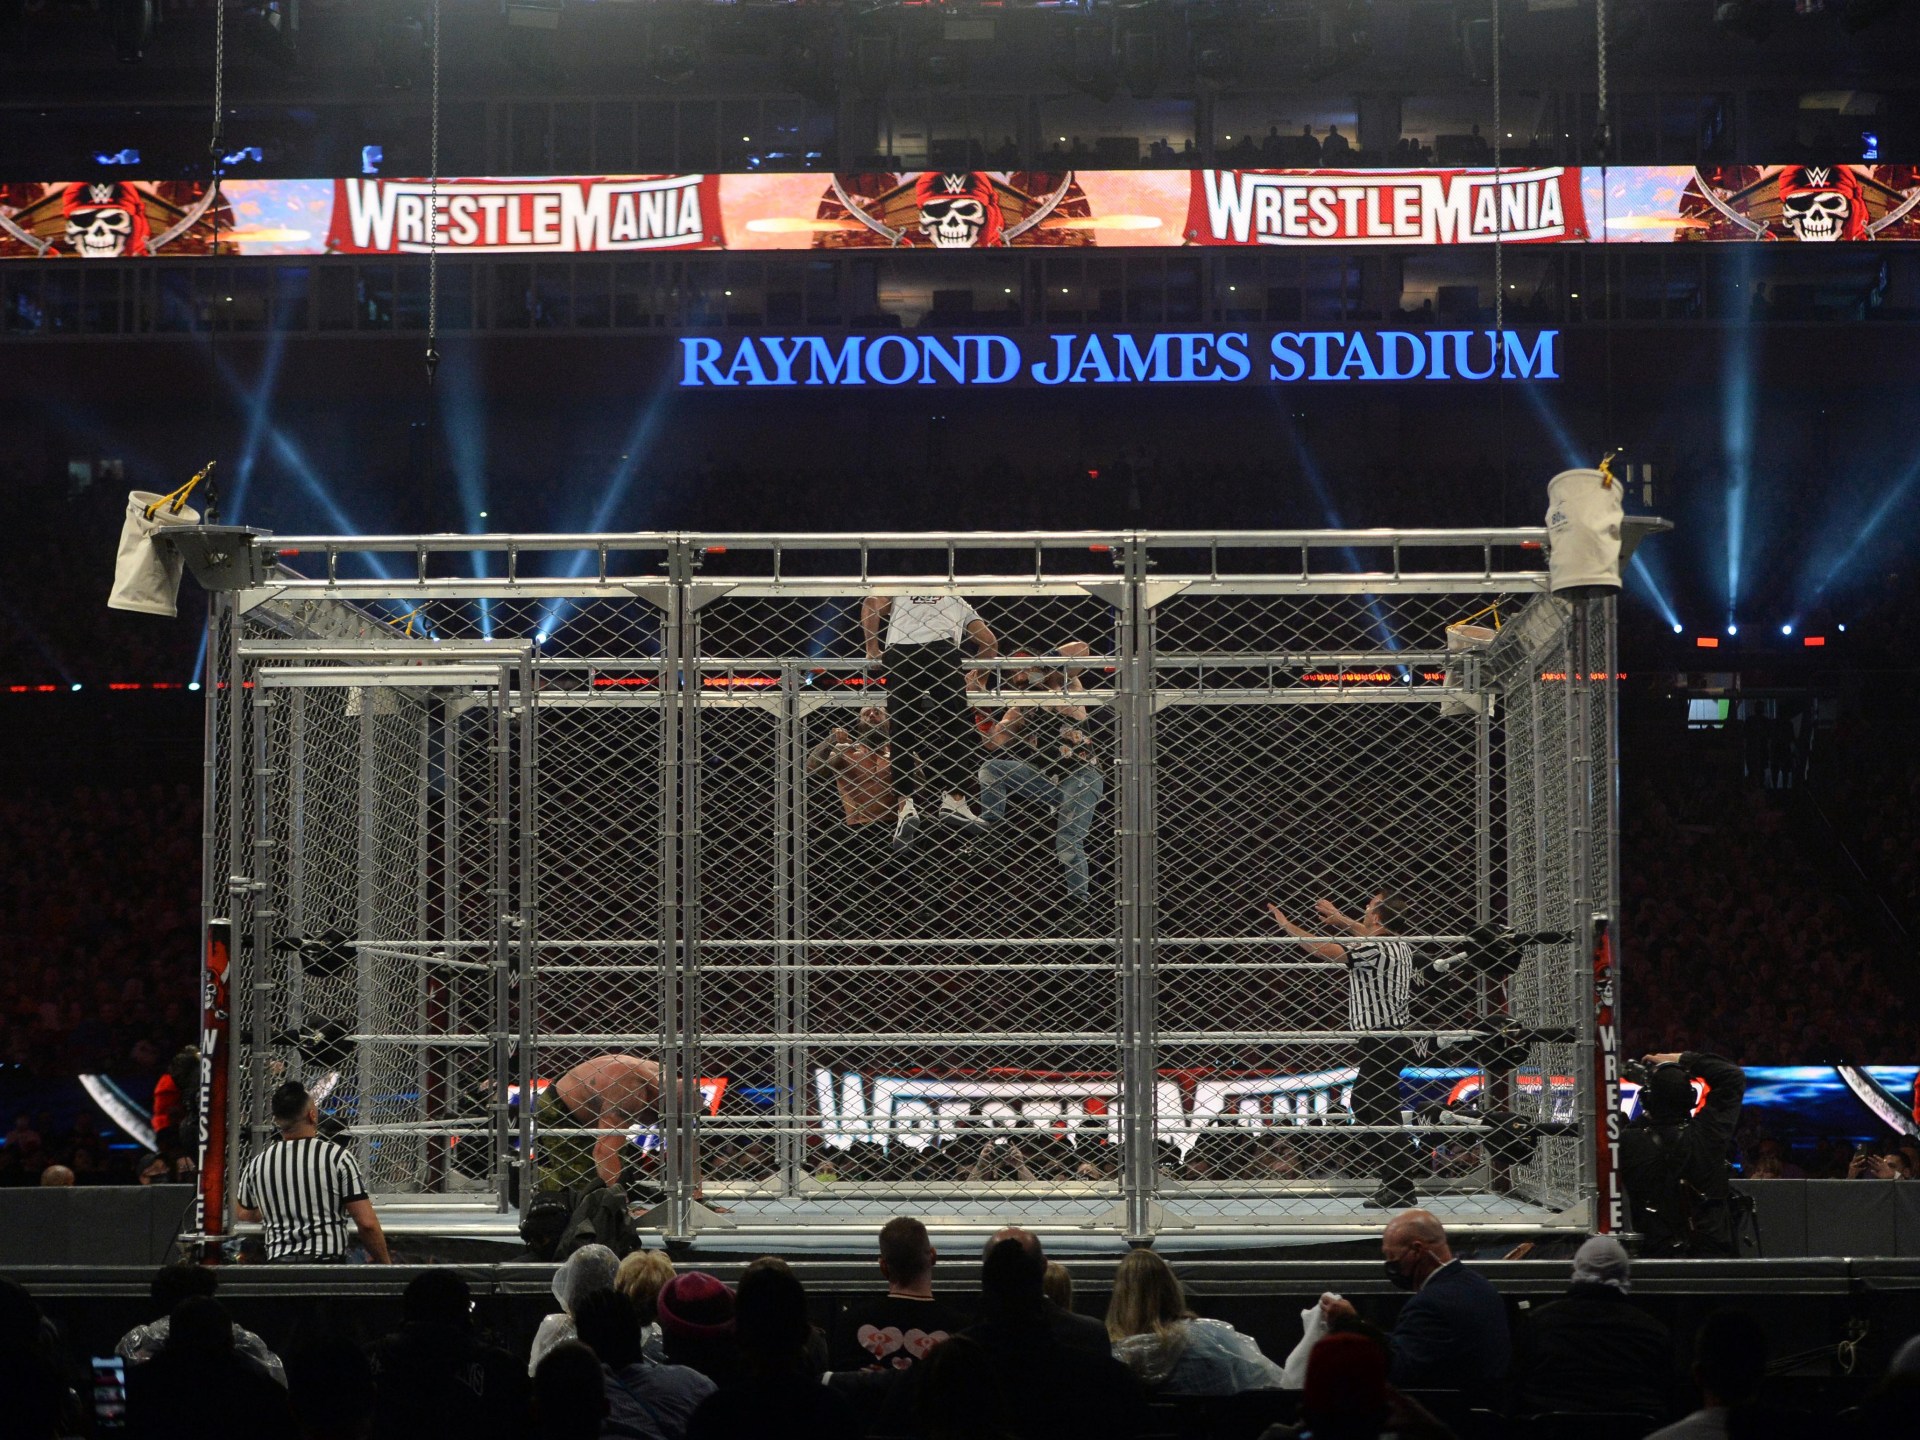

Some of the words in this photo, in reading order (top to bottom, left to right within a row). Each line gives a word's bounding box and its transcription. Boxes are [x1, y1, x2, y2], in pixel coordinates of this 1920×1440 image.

[345, 176, 704, 253] WRESTLEMANIA
[1203, 168, 1565, 245] WRESTLEMANIA
[678, 334, 1022, 387] RAYMOND
[1030, 331, 1252, 385] JAMES
[1269, 330, 1560, 382] STADIUM
[195, 1028, 218, 1244] WRESTLE
[1600, 1025, 1623, 1234] WRESTLE
